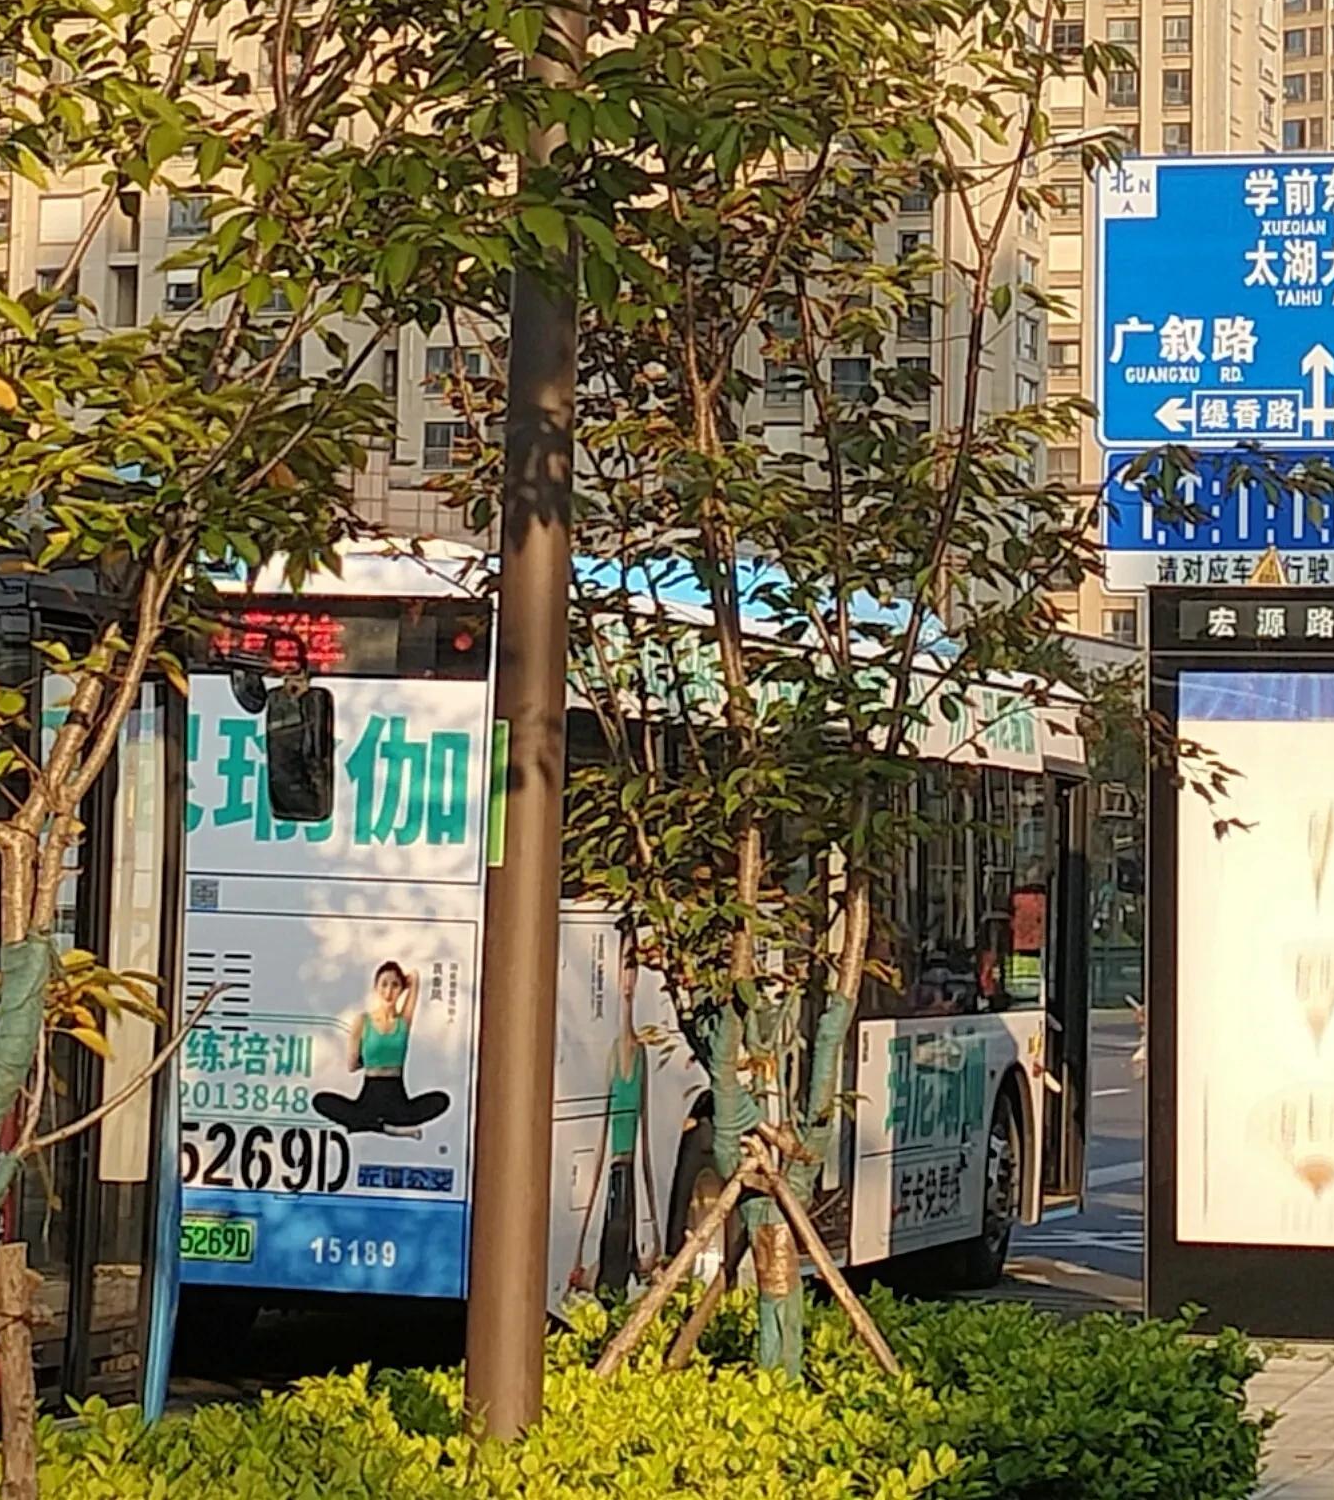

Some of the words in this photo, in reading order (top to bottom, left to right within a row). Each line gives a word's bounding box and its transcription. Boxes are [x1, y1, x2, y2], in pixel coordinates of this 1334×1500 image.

[1109, 168, 1135, 194] 北
[1138, 178, 1151, 194] N
[1275, 288, 1323, 307] TAIHU
[1108, 313, 1259, 364] 广叙路
[1124, 366, 1201, 384] GUANGXU
[1219, 366, 1245, 383] RD.
[1199, 397, 1297, 431] 缇香路
[1156, 553, 1330, 585] 请对应车行驶
[185, 1029, 314, 1078] 练培训
[180, 1225, 251, 1258] 5269D
[309, 1236, 397, 1268] 15189
